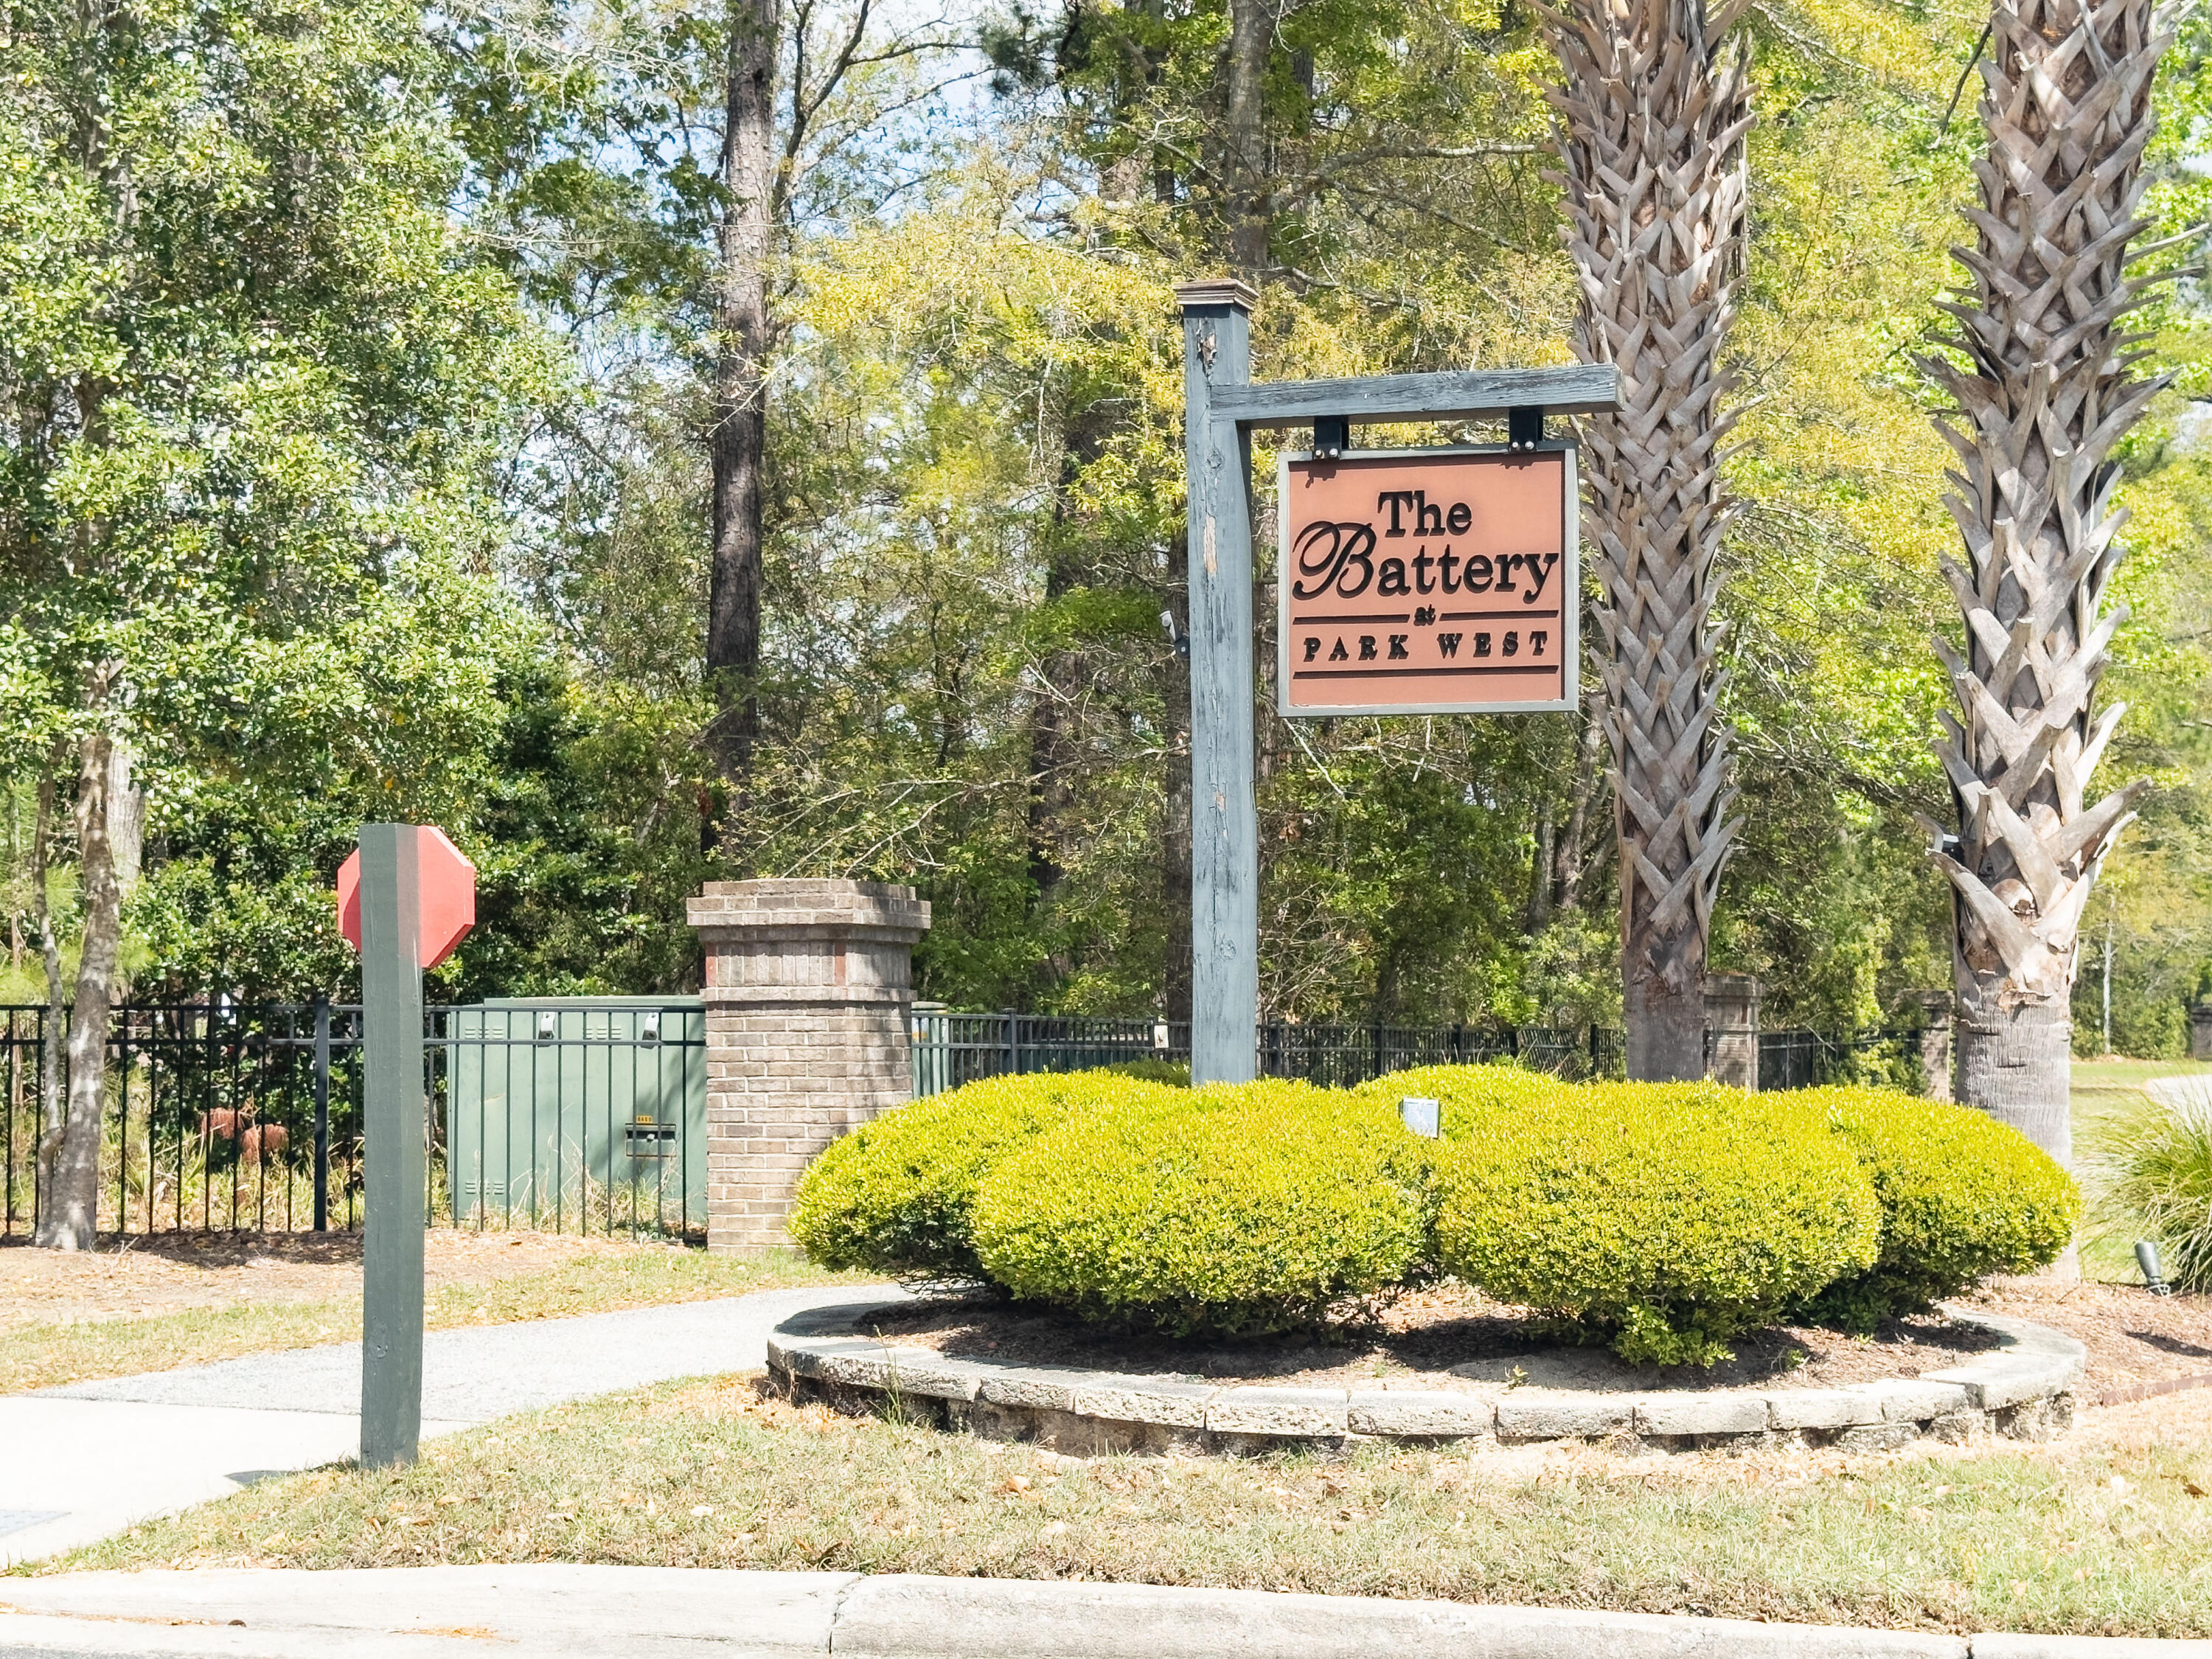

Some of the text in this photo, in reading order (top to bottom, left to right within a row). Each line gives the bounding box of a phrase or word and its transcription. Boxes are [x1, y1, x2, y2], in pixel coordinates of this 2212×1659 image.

[1377, 490, 1472, 538] The
[1292, 521, 1559, 604] Battery
[1413, 604, 1436, 627] at
[1303, 630, 1548, 662] PARK WEST
